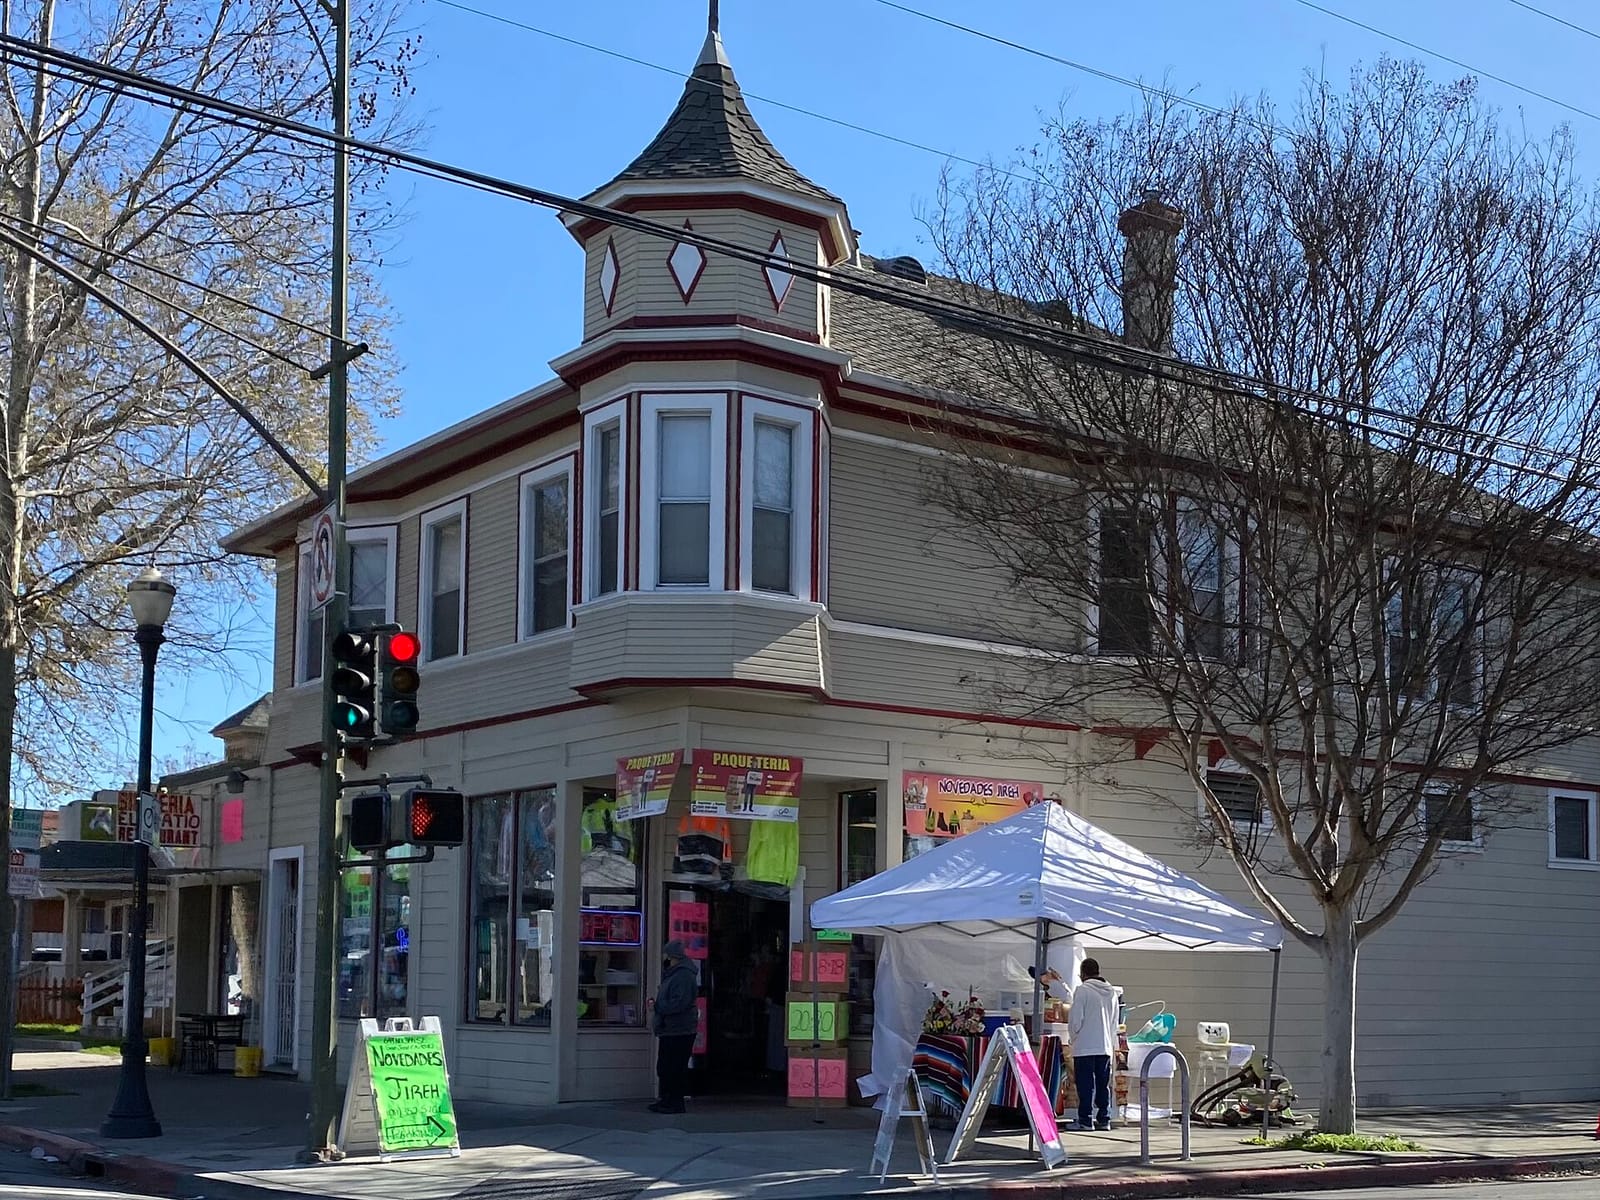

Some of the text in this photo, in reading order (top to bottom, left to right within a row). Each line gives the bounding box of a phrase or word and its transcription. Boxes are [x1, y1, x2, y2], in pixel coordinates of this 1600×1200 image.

[938, 779, 1019, 798] NOVEDADES JIREH
[119, 812, 200, 829] EL ATIO
[119, 827, 198, 845] REURANT
[372, 1046, 443, 1067] NOVEDADES
[385, 1077, 440, 1100] JIREH
